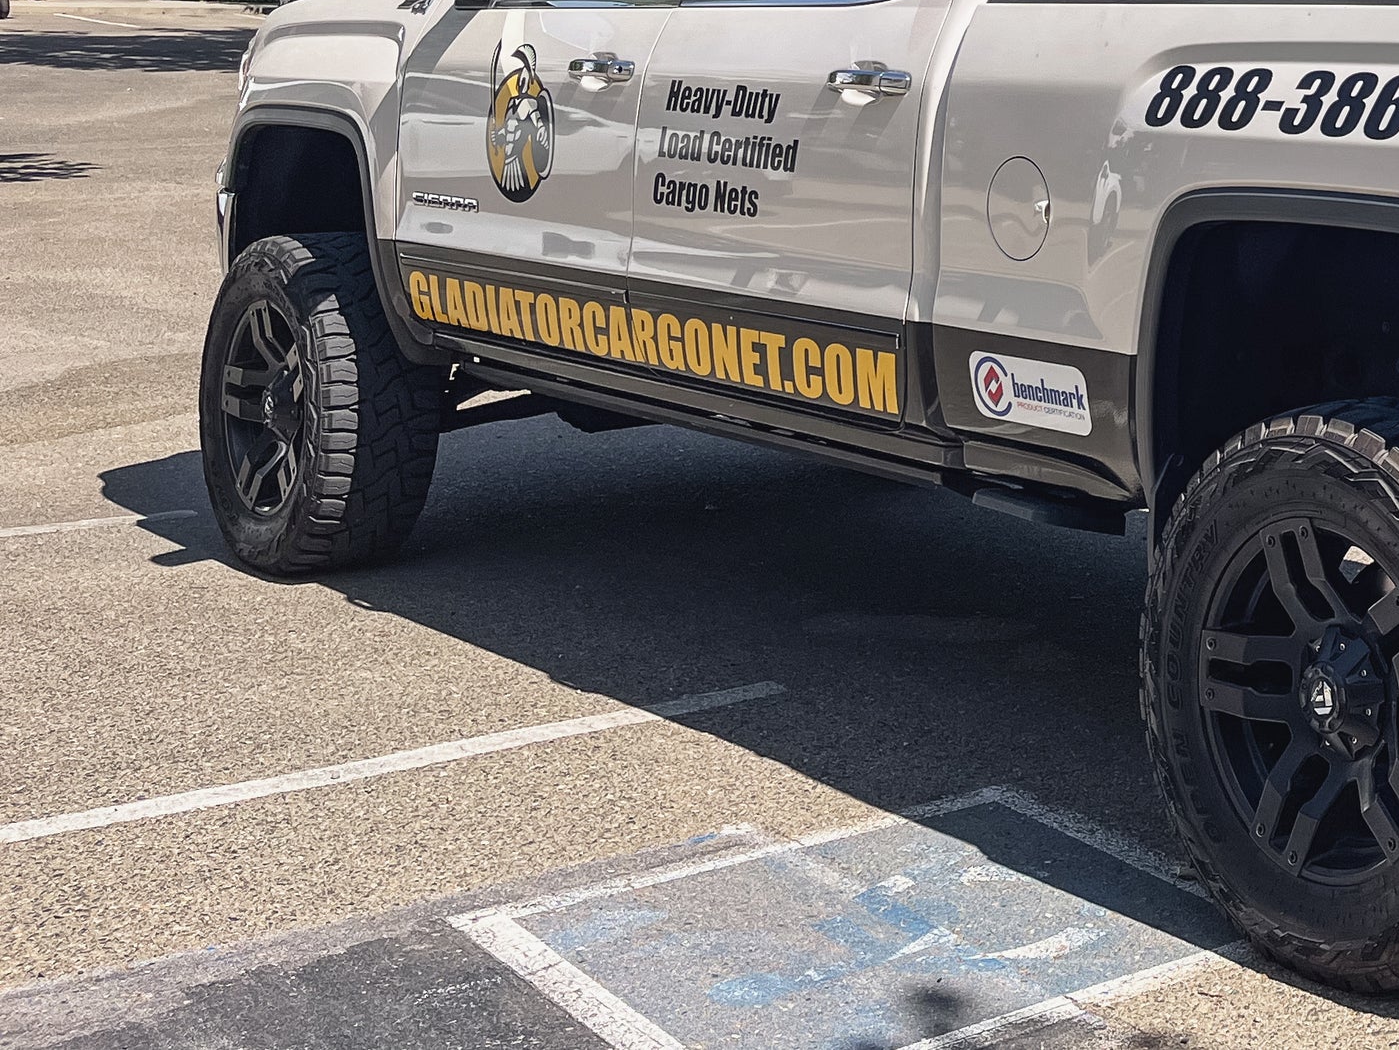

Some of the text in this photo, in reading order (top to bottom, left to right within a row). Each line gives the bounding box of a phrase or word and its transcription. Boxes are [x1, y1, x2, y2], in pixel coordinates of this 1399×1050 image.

[666, 79, 782, 124] Heavy-Duty
[658, 126, 799, 173] Load Certified
[653, 172, 759, 218] Cargo Nets
[408, 270, 899, 415] GLADIATORCARGONET.COM
[1011, 372, 1086, 411] benchmark
[1017, 401, 1085, 420] PRODUCT CERTIFICATION
